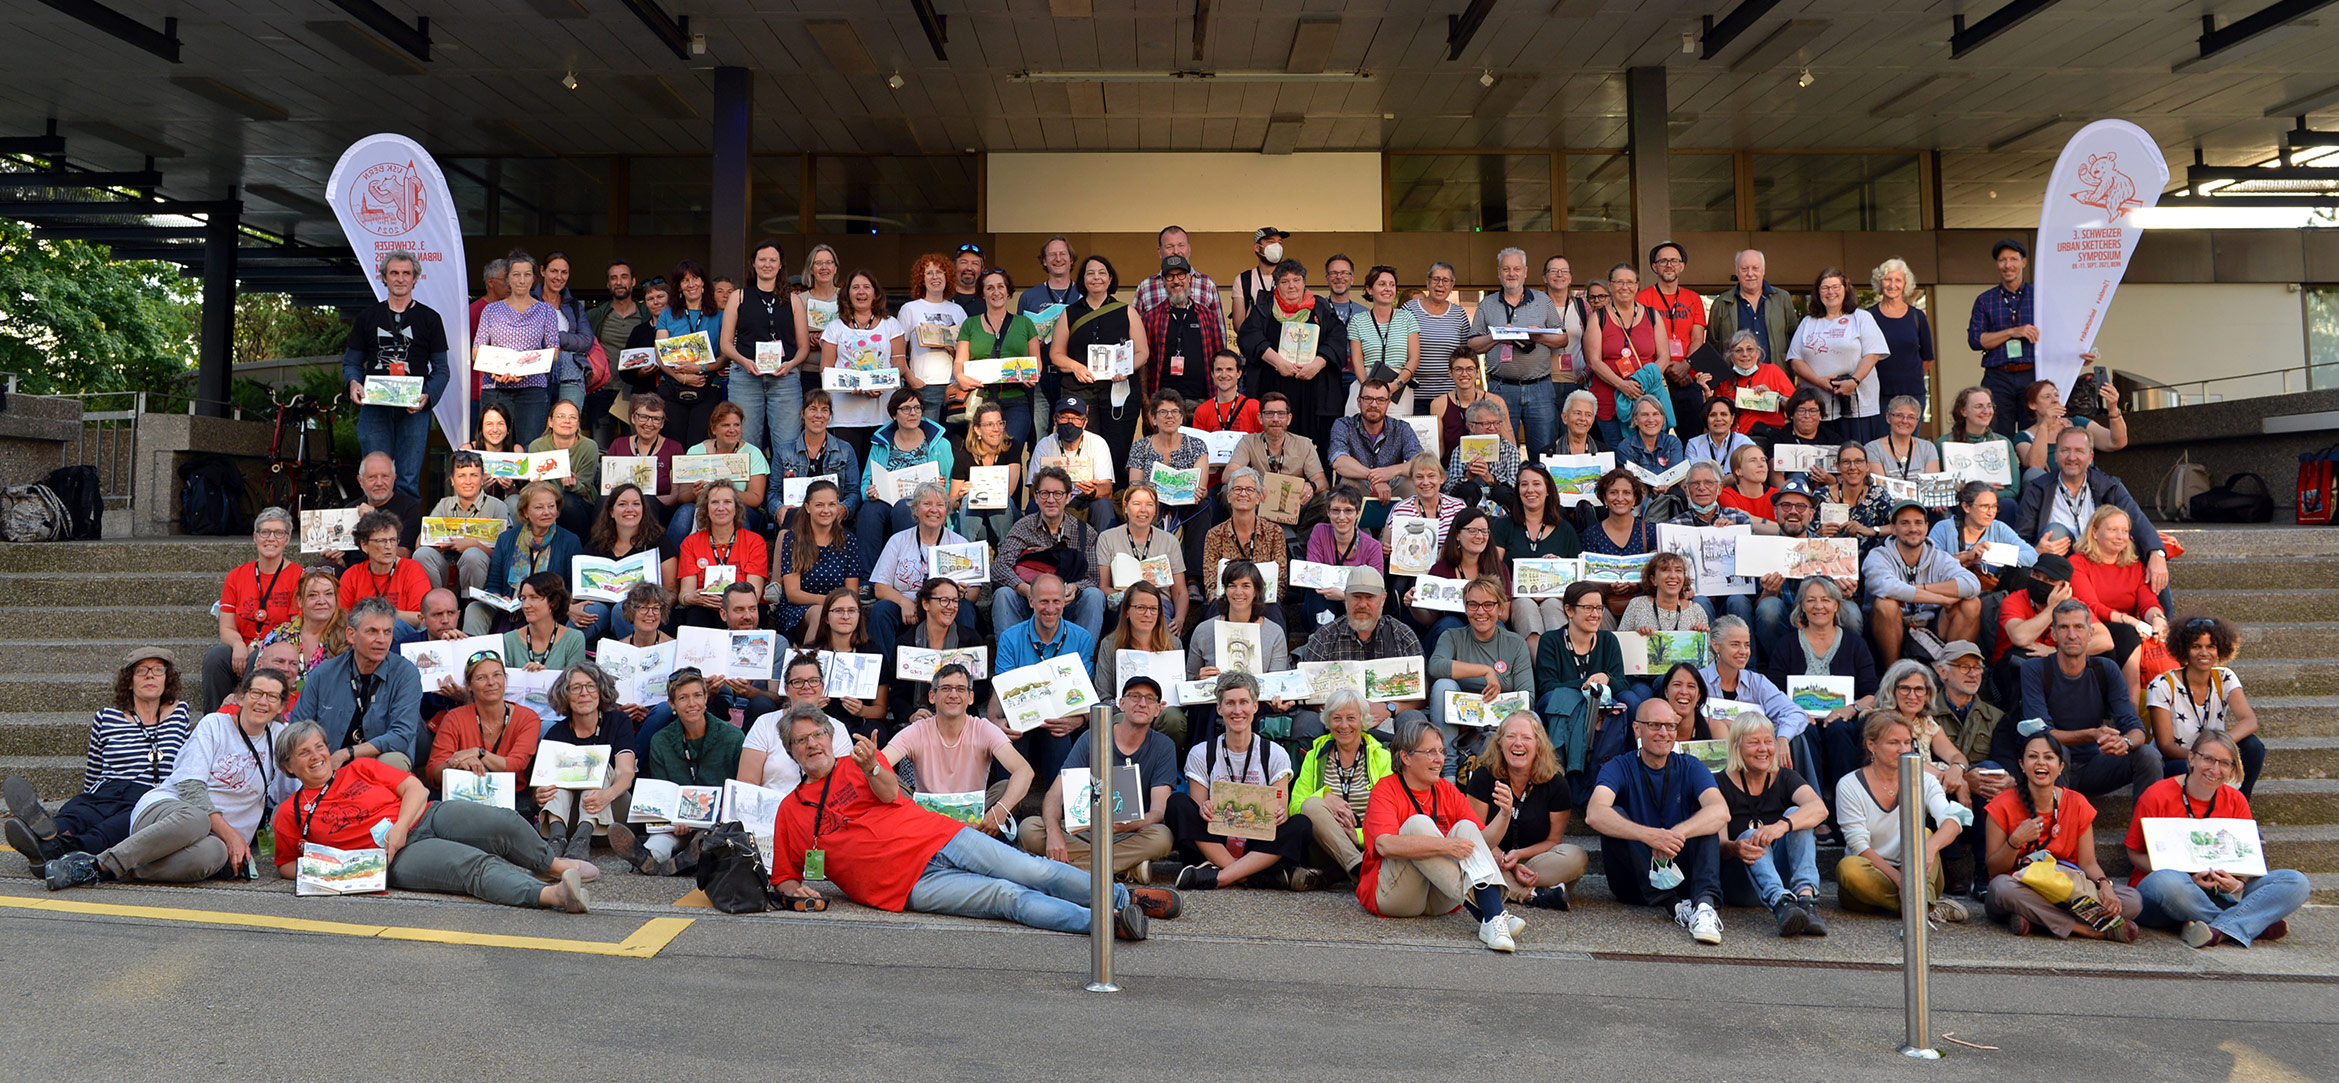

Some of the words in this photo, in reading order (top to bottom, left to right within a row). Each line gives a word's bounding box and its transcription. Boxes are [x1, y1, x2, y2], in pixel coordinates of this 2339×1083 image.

[2073, 229, 2080, 240] 3.
[2082, 228, 2122, 239] SCHWEIZER
[2057, 241, 2080, 252] URBAN
[2082, 239, 2122, 250] SKETCHERS
[2078, 250, 2122, 262] SYMPOSIUM
